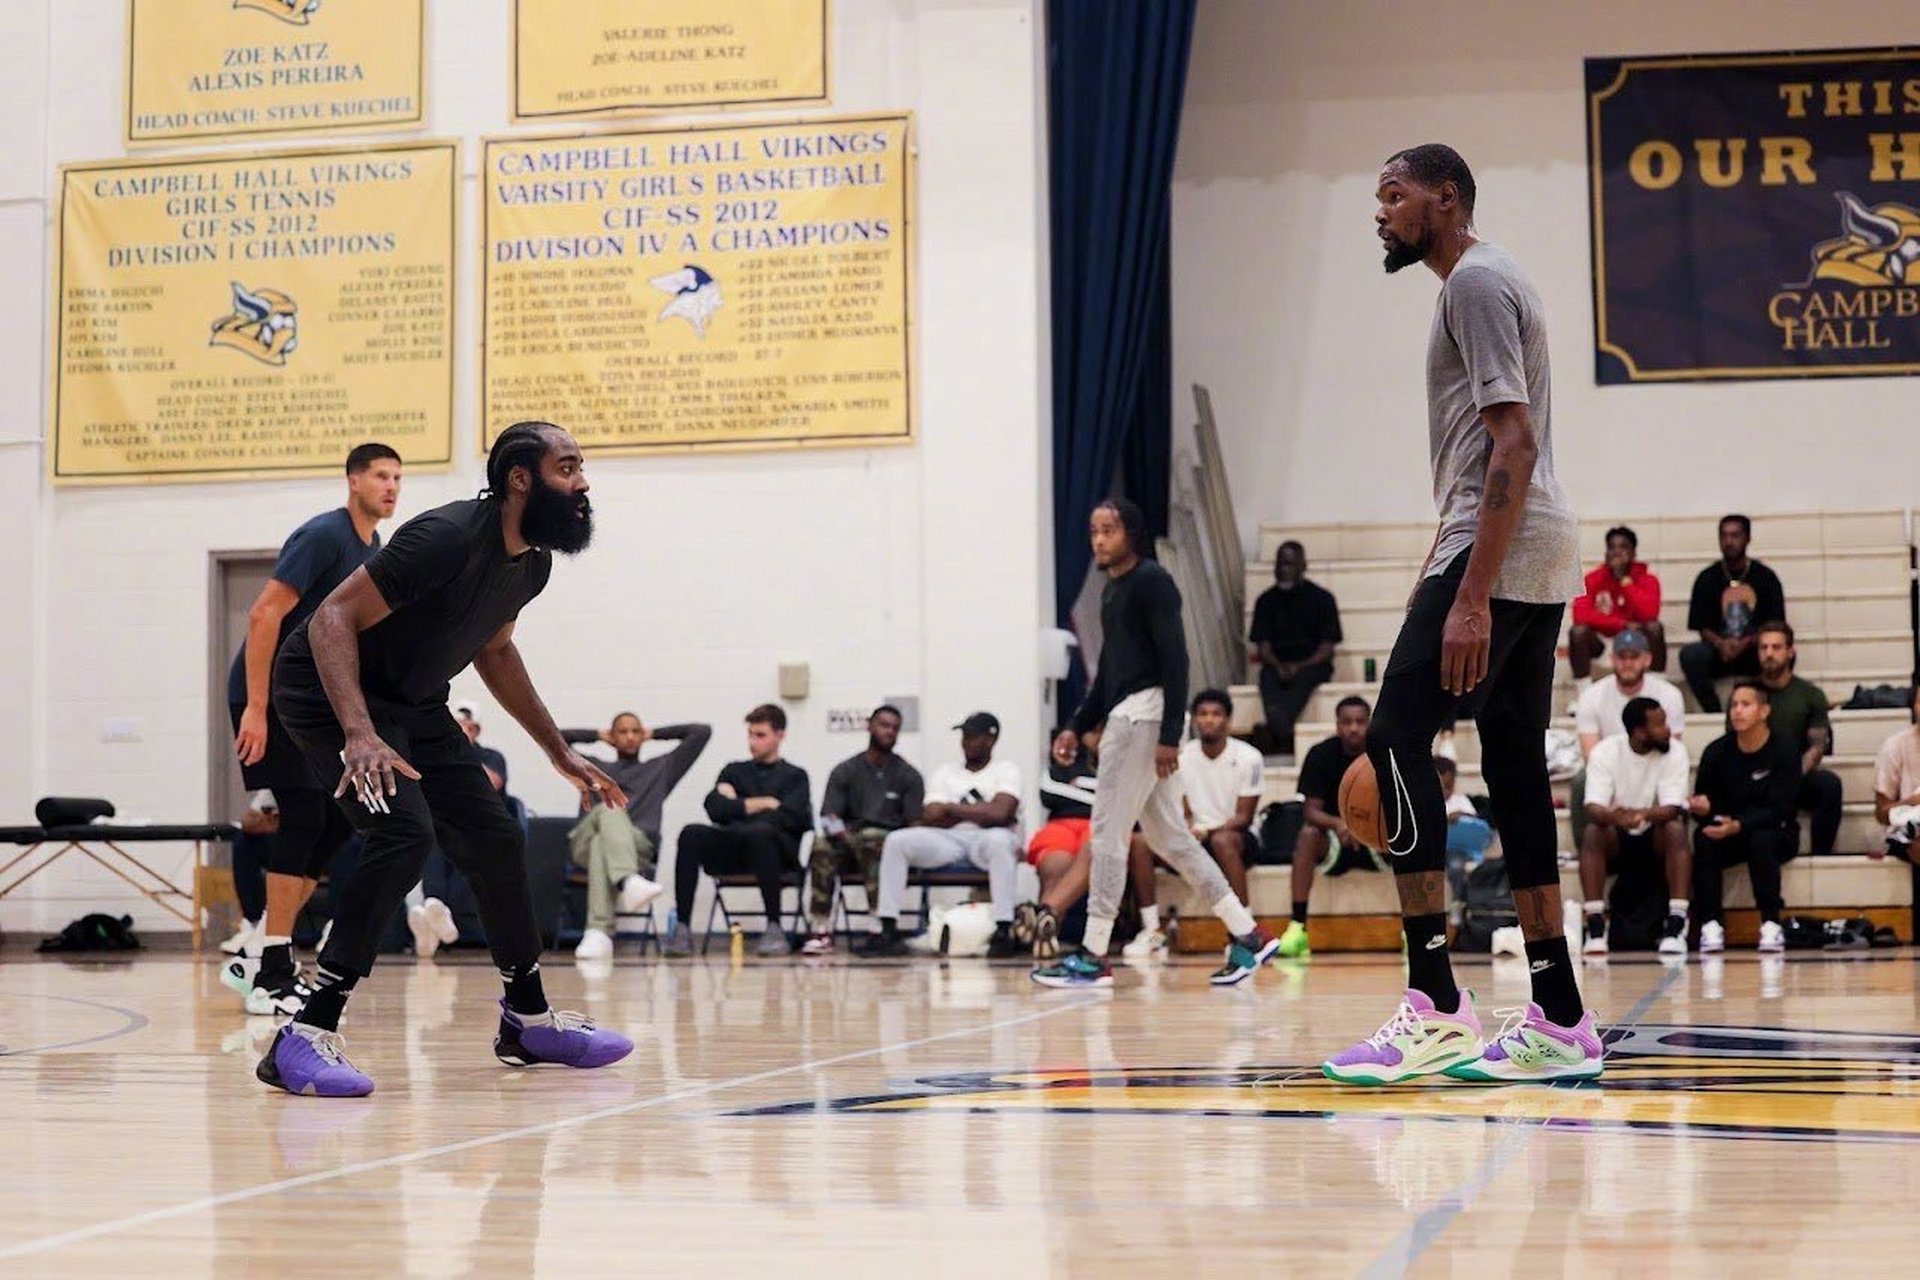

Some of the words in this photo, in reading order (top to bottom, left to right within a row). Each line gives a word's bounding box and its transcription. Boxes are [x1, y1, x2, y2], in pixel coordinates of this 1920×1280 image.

[224, 46, 264, 66] ZOE
[273, 43, 329, 62] KATZ
[704, 45, 746, 60] KATZ
[189, 72, 263, 92] ALEXIS
[272, 65, 364, 85] PEREIRA
[137, 113, 188, 129] HEAD
[267, 104, 322, 122] STEVE
[331, 97, 414, 117] KUECHEL
[1779, 79, 1920, 118] THIS
[498, 146, 654, 175] CAMPBELL
[669, 141, 747, 166] HALL
[761, 131, 888, 160] VIKINGS
[1629, 136, 1817, 190] OUR
[94, 172, 224, 198] CAMPBELL
[235, 167, 299, 189] HALL
[310, 160, 413, 184] VIKINGS
[498, 179, 611, 204] VARSITY
[716, 163, 886, 194] BASKETBALL
[166, 193, 237, 217] GIRLS
[250, 188, 336, 211] TENNIS
[715, 200, 778, 222] 2012
[267, 213, 318, 235] 2012
[496, 234, 623, 262] DIVISION
[639, 232, 668, 255] IV
[680, 230, 698, 252] A
[711, 219, 890, 251] CHAMPIONS
[109, 242, 217, 267] DIVISION
[229, 240, 235, 260] I
[244, 233, 396, 260] CHAMPIONS
[1769, 289, 1920, 327] CAMPB
[1783, 317, 1890, 350] HALL
